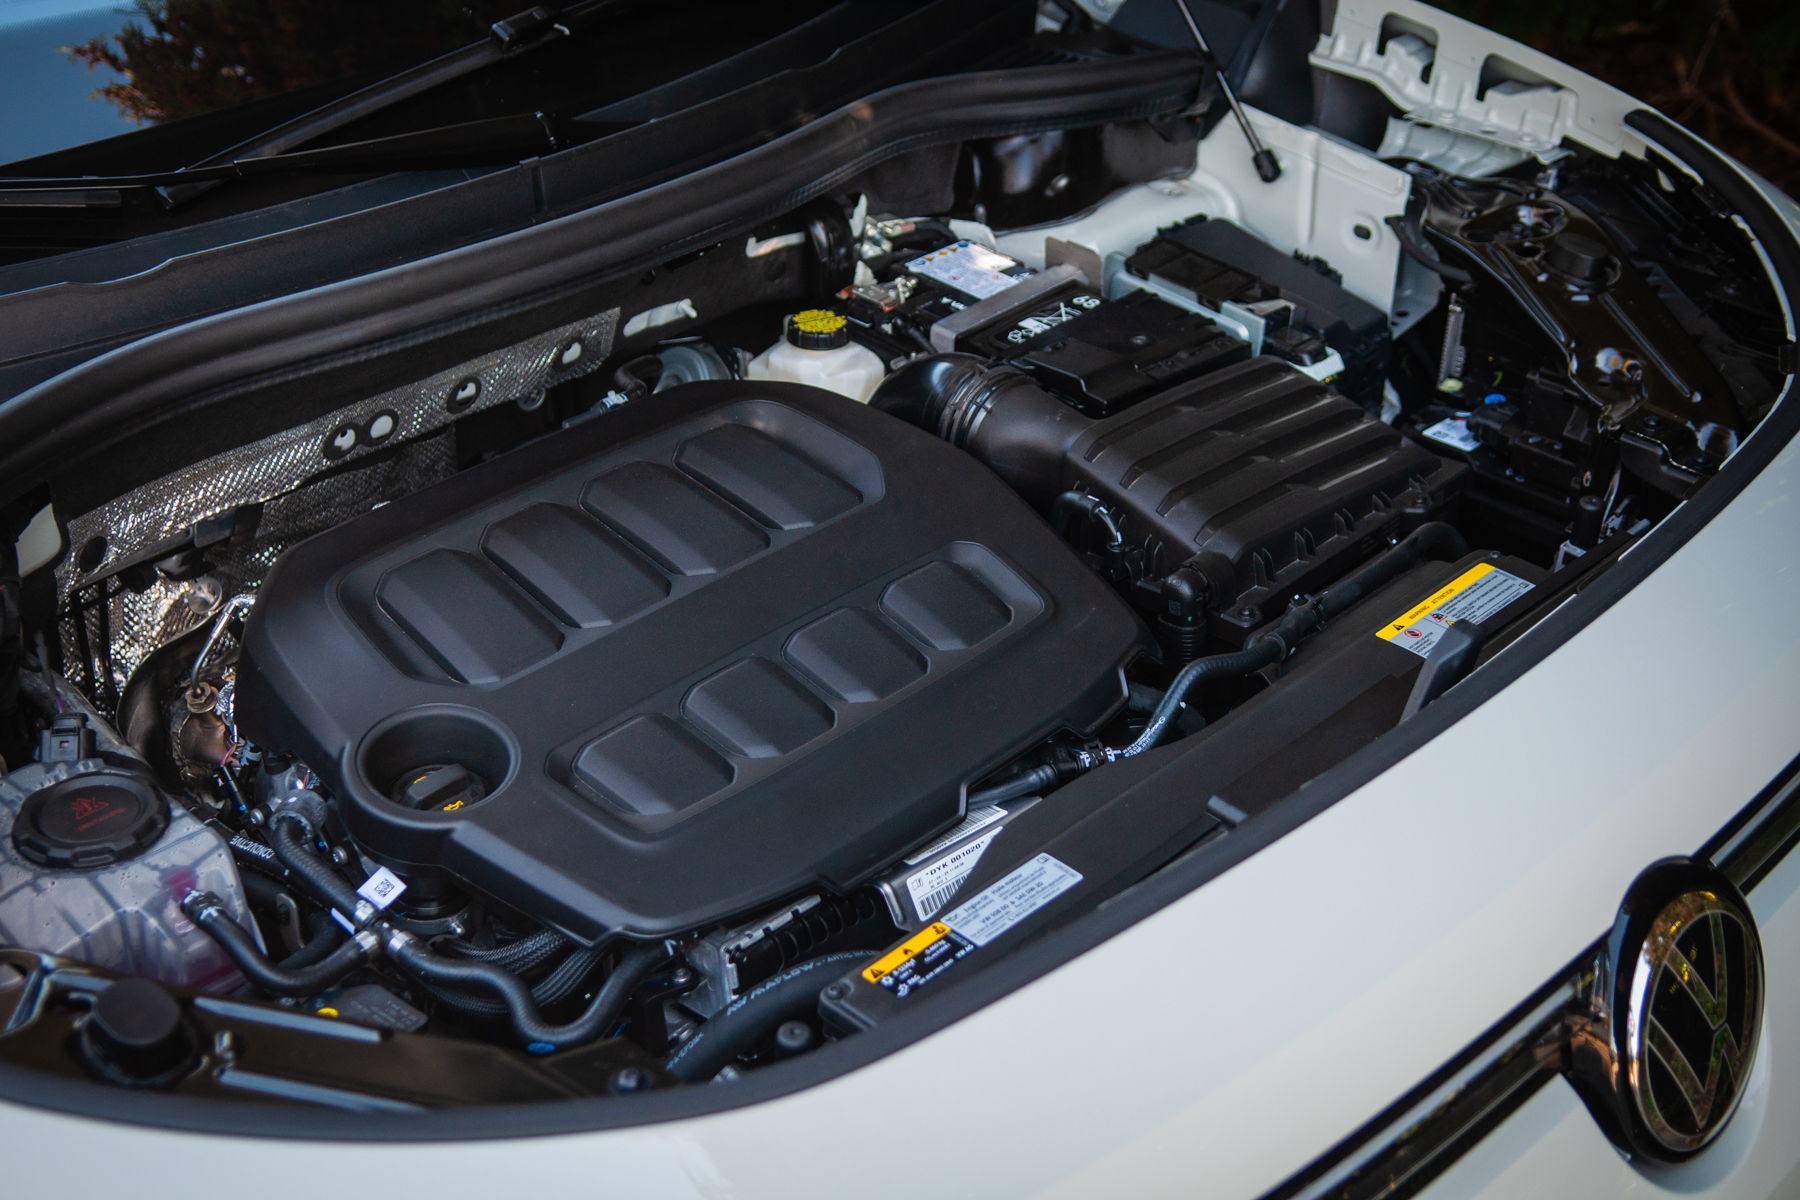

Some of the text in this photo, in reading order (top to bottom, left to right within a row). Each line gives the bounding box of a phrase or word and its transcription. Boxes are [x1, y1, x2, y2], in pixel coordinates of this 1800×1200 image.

[1072, 295, 1101, 309] 68
[1407, 605, 1430, 620] WARNING
[1421, 588, 1445, 604] ATTENTION
[230, 835, 276, 859] CONDUCTIVE
[980, 915, 991, 924] VW
[1014, 892, 1027, 901] SAE
[751, 961, 814, 999] MAFLOW
